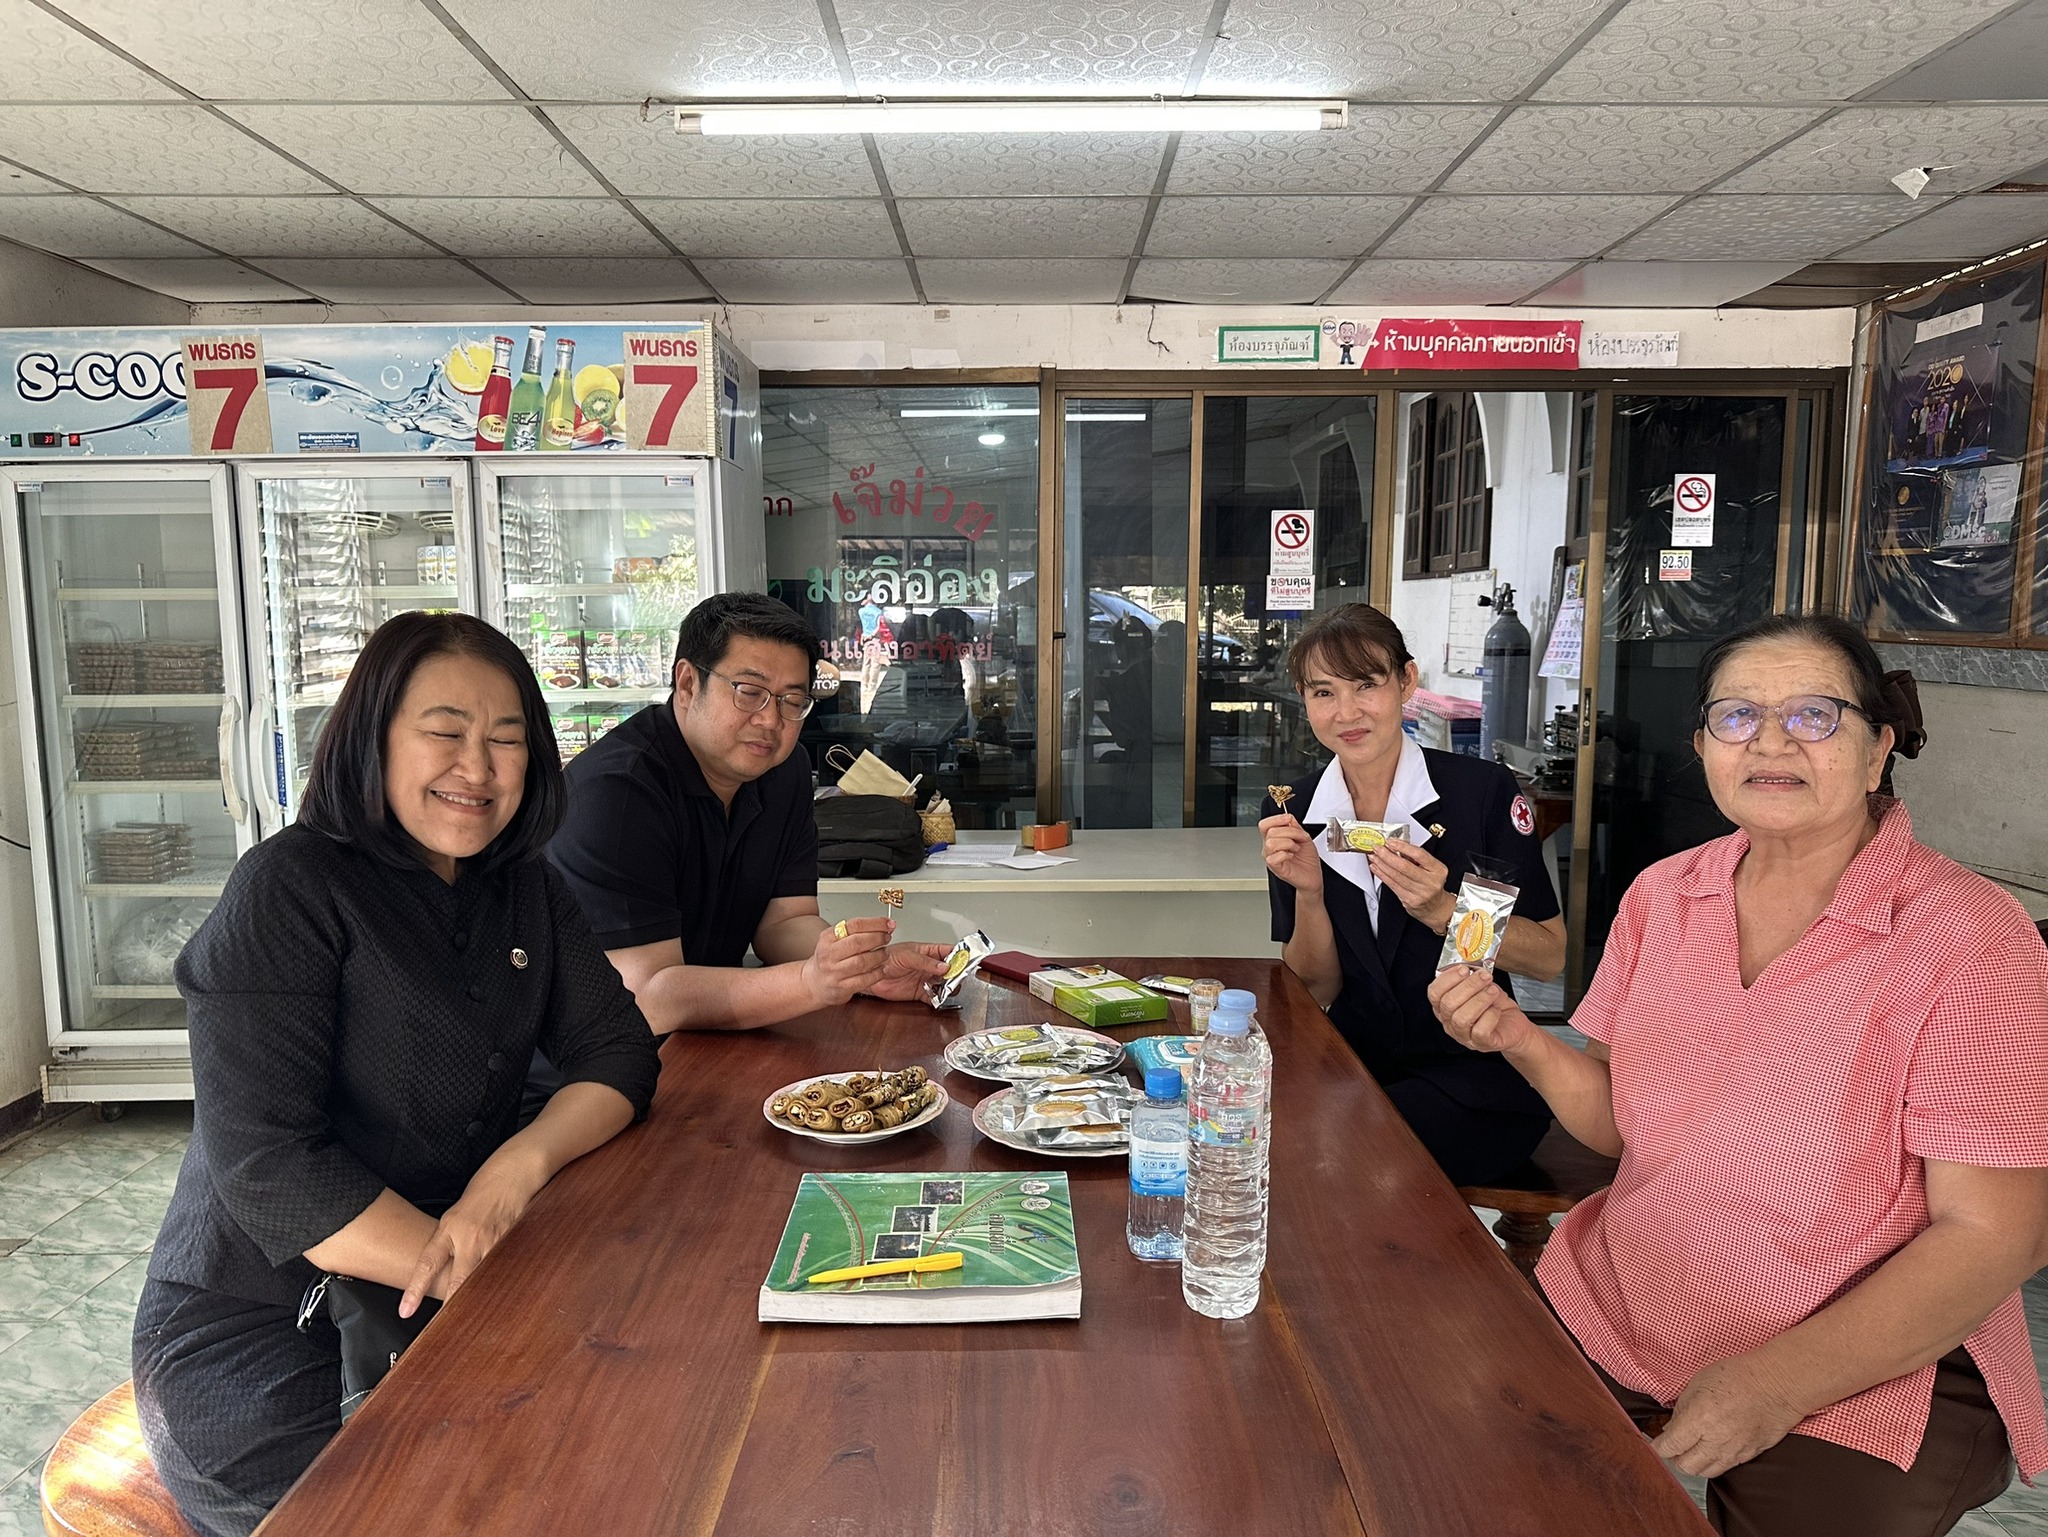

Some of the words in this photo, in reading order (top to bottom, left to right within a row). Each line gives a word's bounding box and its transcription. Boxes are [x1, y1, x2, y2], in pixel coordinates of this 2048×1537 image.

[1228, 335, 1311, 355] ห้องบรรจุภัณฑ์
[1384, 329, 1576, 358] ห้ามบุคคลภายนอกเข้า
[193, 367, 259, 450] 7
[633, 364, 698, 446] 7
[724, 375, 738, 460] 7
[832, 463, 996, 542] เจ๊ม่วย
[806, 553, 999, 605] มะลิอ่อง
[1661, 555, 1690, 568] 92.50
[817, 667, 834, 680] love
